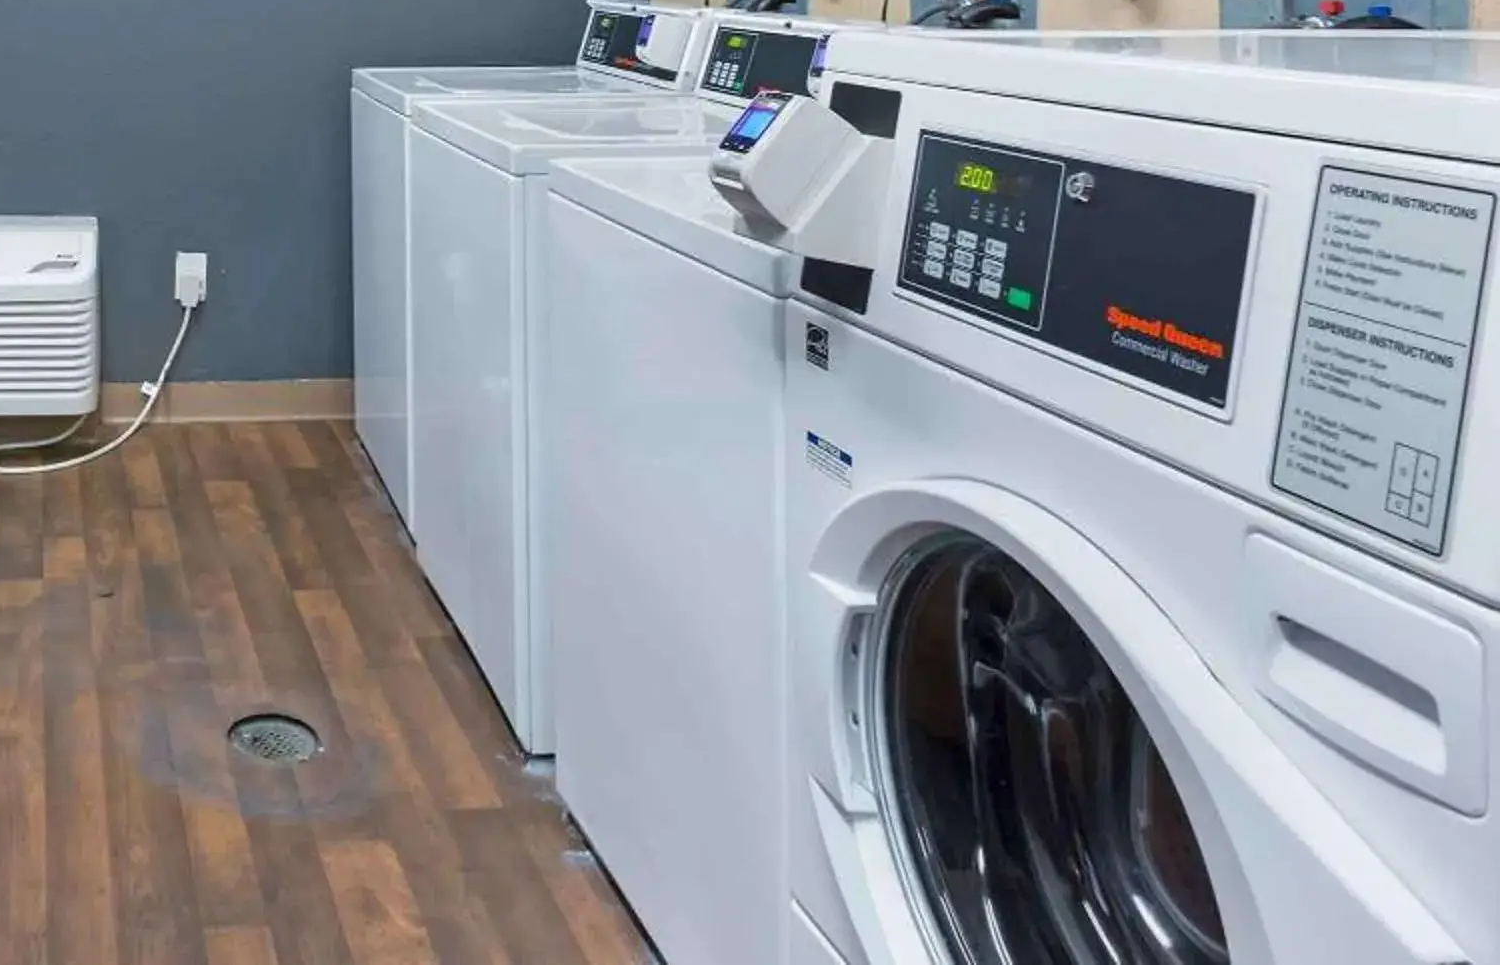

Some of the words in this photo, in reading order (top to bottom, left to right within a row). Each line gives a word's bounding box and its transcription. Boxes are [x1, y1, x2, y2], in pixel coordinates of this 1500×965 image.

[1329, 184, 1389, 204] OPERATING
[1392, 196, 1477, 220] INSTRUCTIONS
[1107, 306, 1162, 338] Speed
[1164, 322, 1224, 359] Queen
[1111, 330, 1168, 363] Commercial
[1170, 350, 1210, 377] Washer
[1308, 316, 1367, 342] DISPENSER
[1369, 335, 1454, 369] INSTRUCTIONS
